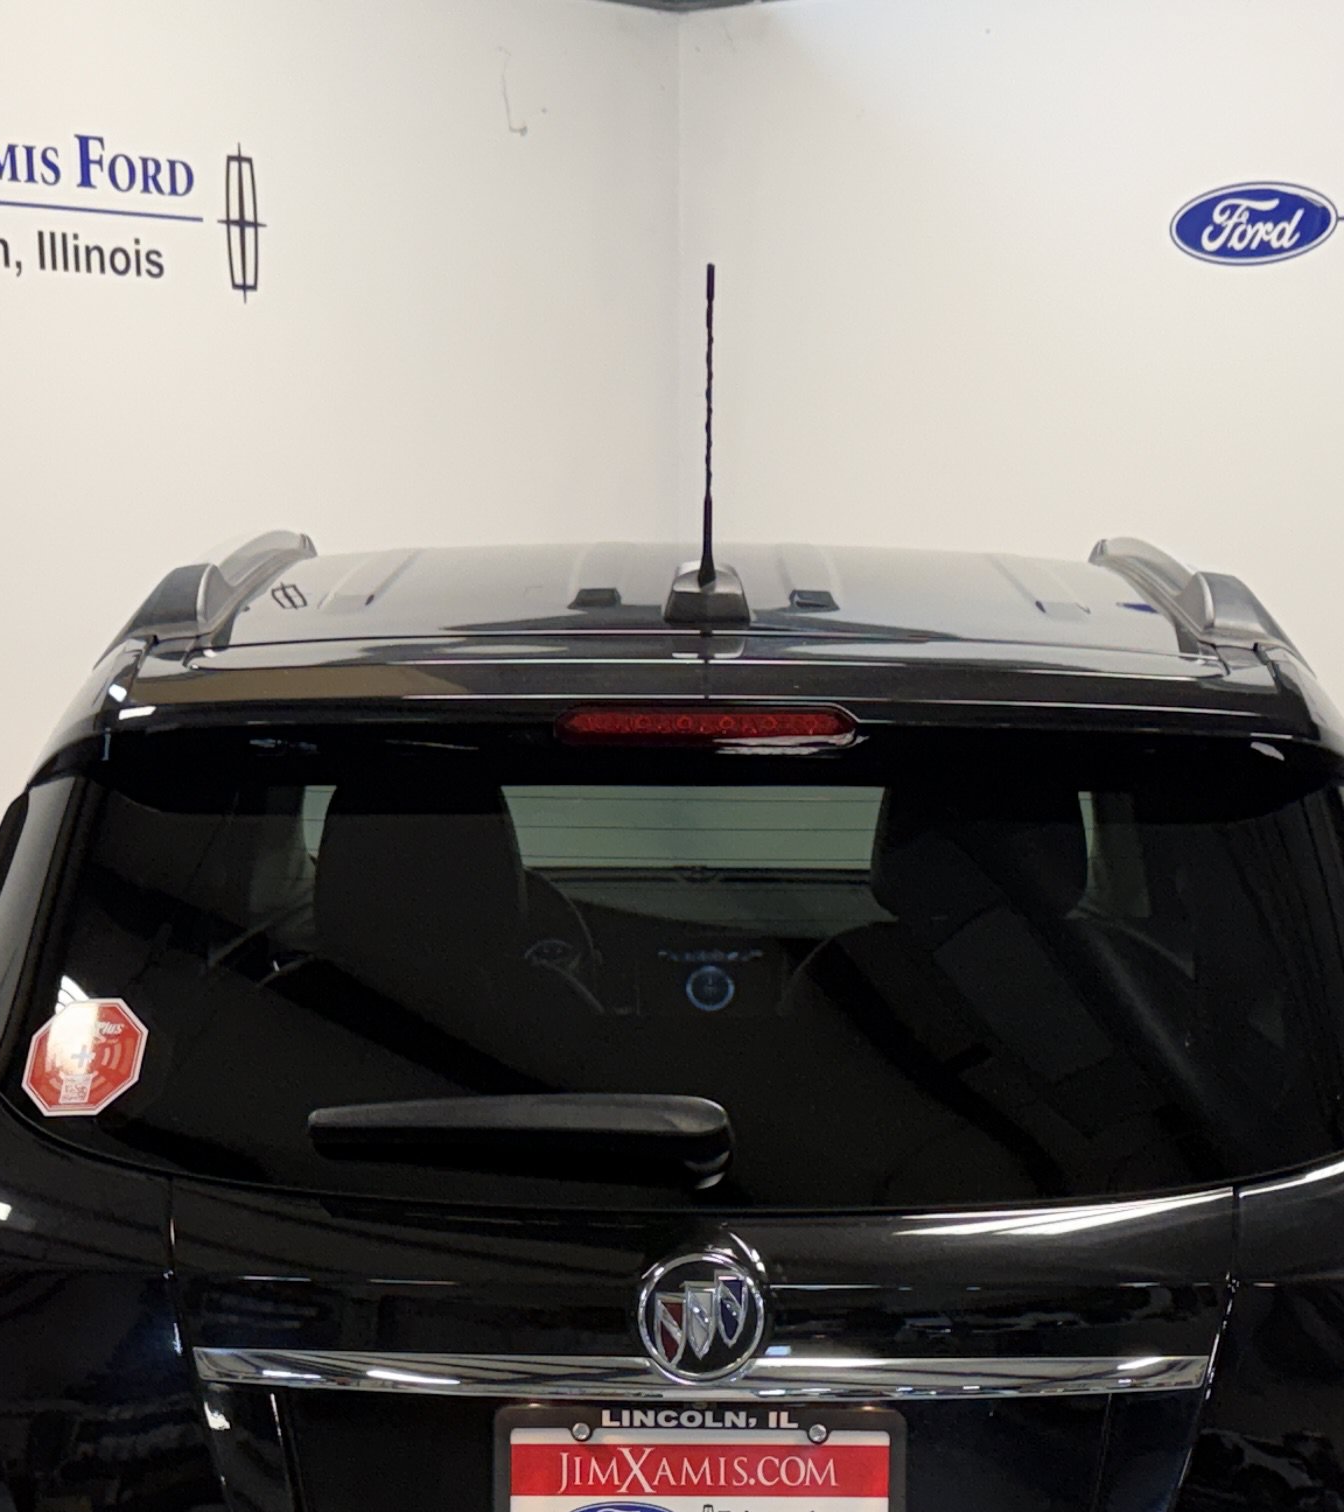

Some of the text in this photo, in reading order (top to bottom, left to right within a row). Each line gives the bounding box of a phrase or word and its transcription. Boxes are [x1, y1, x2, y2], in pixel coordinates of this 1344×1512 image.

[74, 133, 196, 198] FORD
[1201, 197, 1302, 252] Ford
[36, 231, 165, 279] Illinois
[601, 1409, 799, 1430] LINCOLN, IL
[558, 1447, 839, 1494] JIMXAMIS.COM
